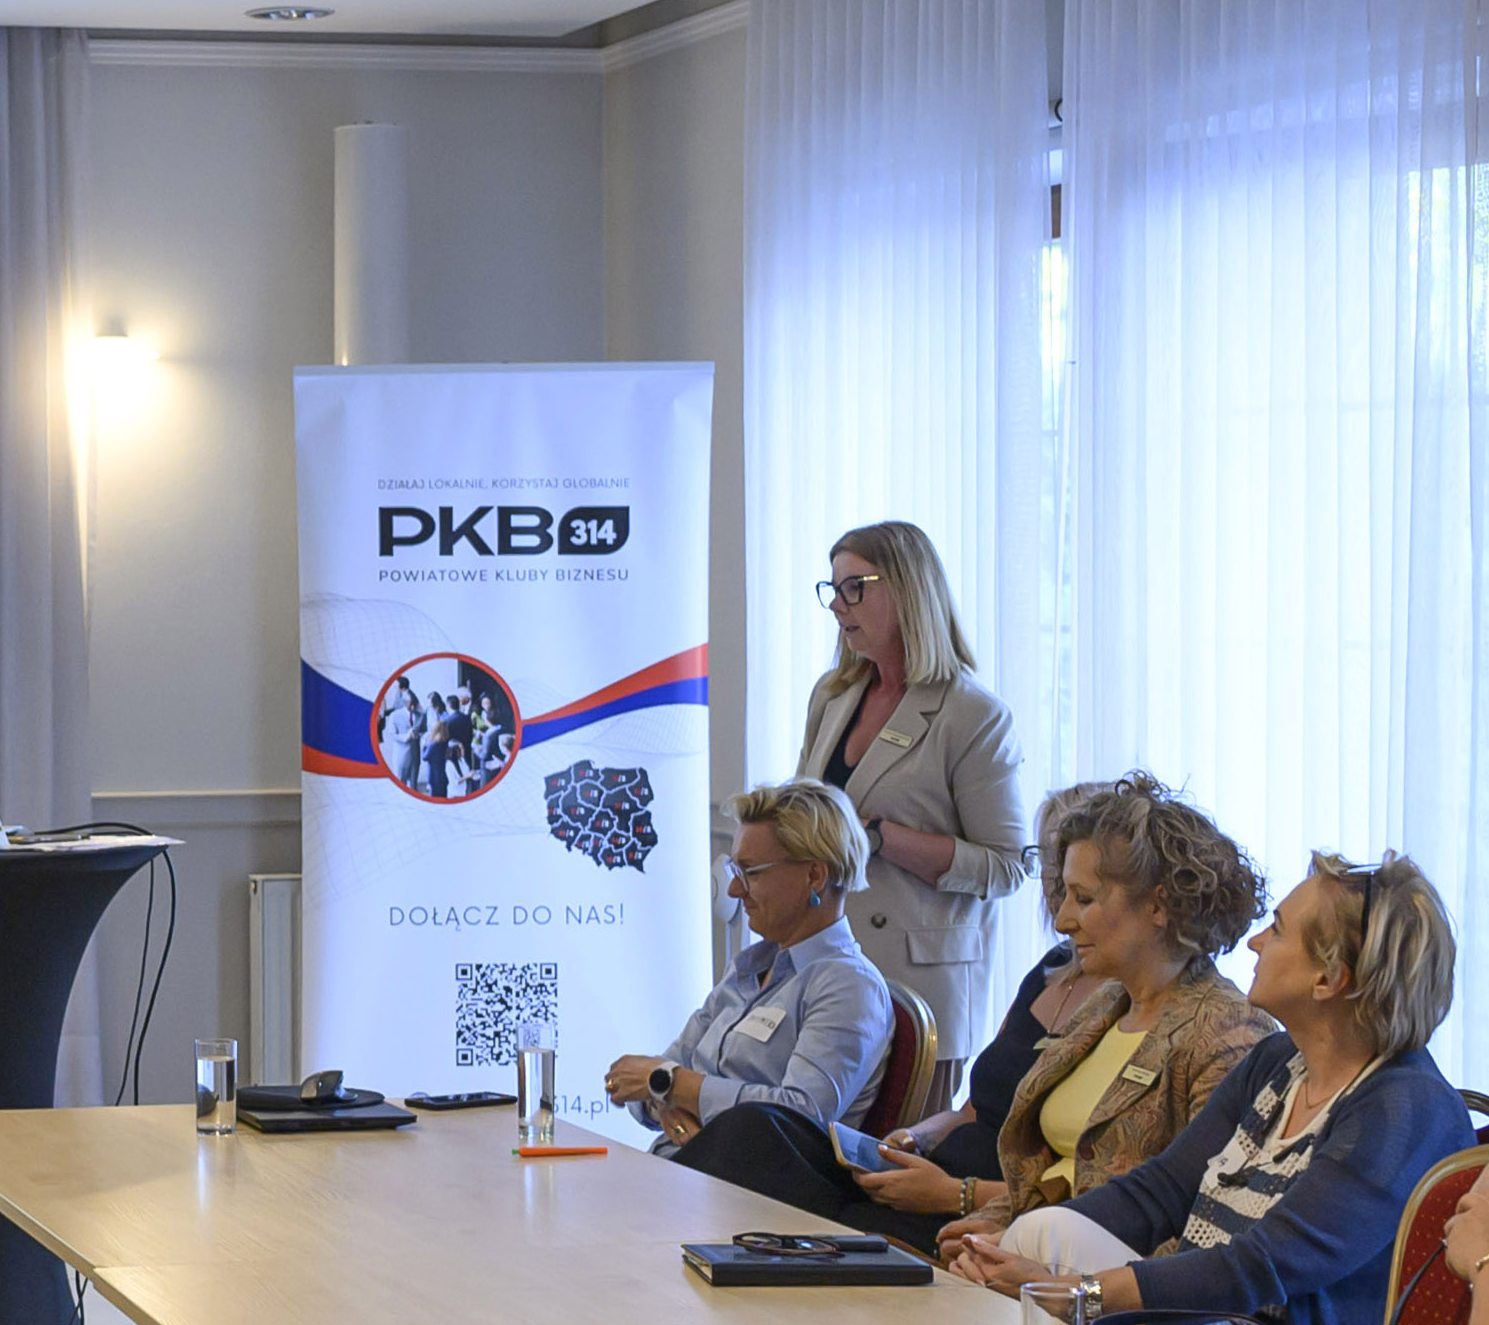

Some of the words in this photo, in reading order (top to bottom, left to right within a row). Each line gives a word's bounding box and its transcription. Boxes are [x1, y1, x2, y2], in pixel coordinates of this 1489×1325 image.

[377, 479, 426, 491] DZIAŁAJ
[491, 477, 560, 490] KORZYSTAJ
[562, 477, 631, 489] GLOBALNIE
[378, 505, 555, 557] PKB
[569, 519, 618, 546] 314
[378, 570, 489, 583] POWIATOWE
[494, 569, 550, 582] KLUBY
[555, 568, 630, 582] BIZNESU
[388, 905, 500, 932] DOŁĄCZ
[512, 905, 553, 926] DO
[565, 903, 625, 926] NAS!
